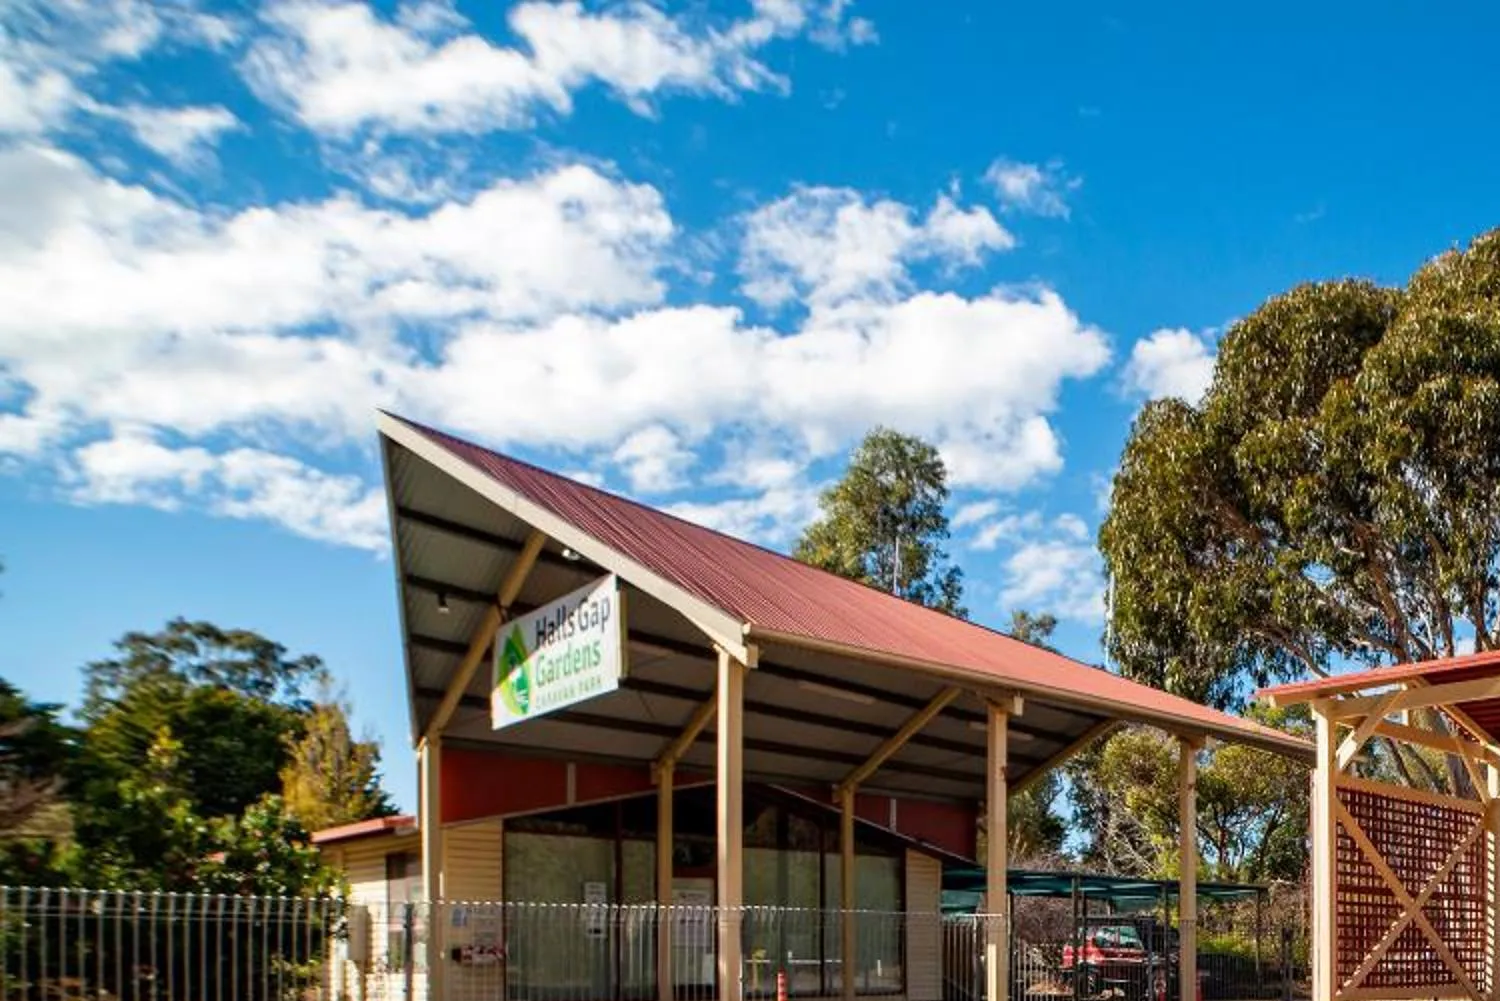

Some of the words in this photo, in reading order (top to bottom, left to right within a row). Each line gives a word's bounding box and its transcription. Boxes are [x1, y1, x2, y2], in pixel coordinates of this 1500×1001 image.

[536, 604, 575, 651] Halls
[577, 595, 611, 634] Gap
[536, 641, 602, 688] Gardens
